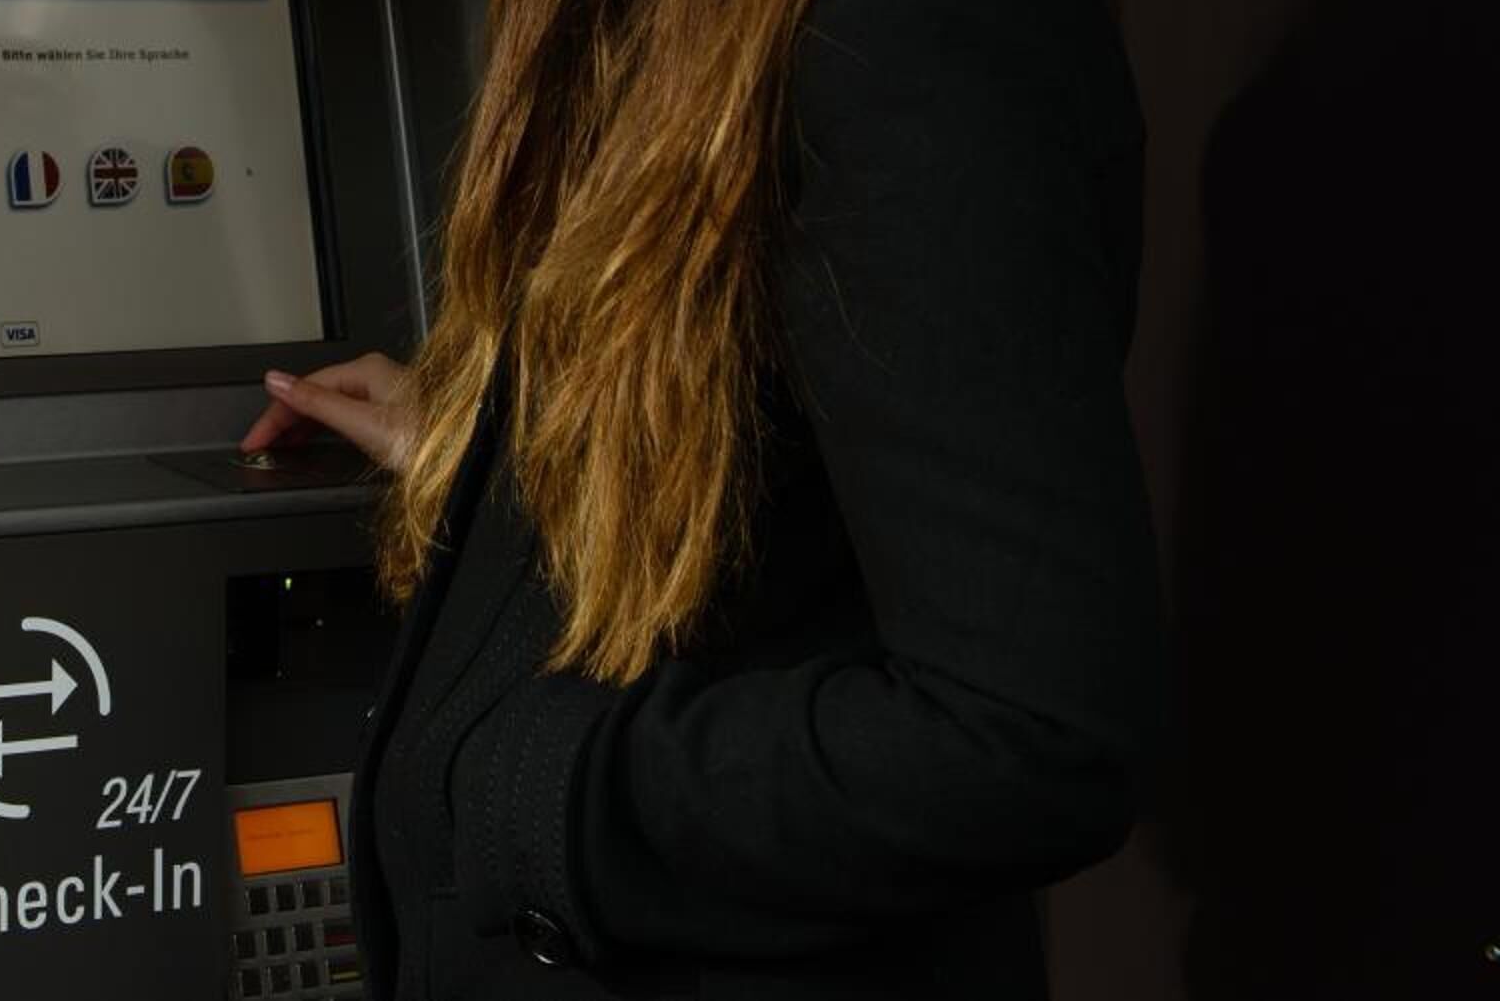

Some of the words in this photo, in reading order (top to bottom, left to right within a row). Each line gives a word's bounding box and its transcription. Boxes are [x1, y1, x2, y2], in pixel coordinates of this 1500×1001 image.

[1, 48, 33, 62] Bitte
[35, 48, 83, 62] wählen
[85, 48, 106, 62] Sie
[108, 48, 136, 62] Ihre
[138, 48, 190, 64] Sprache
[6, 328, 35, 340] VISA
[96, 768, 202, 830] 24/7
